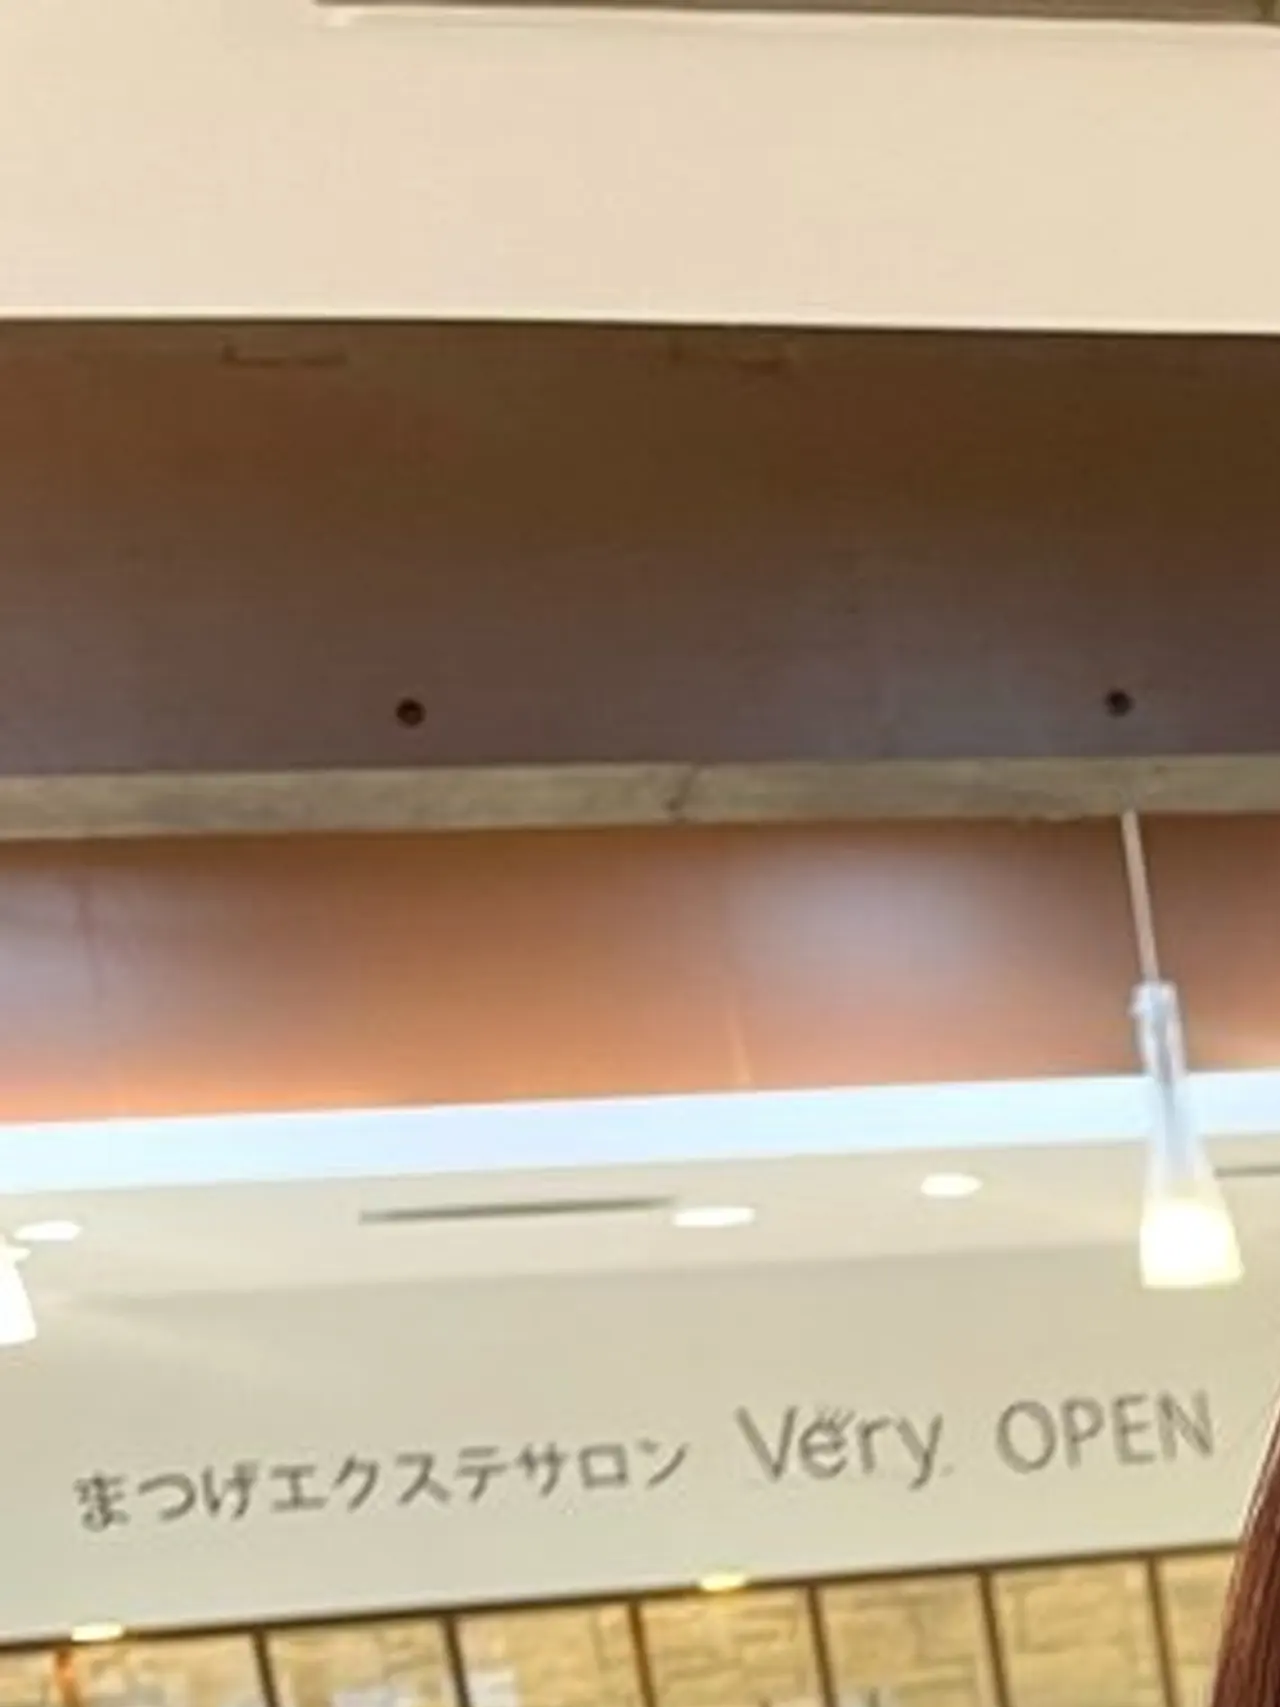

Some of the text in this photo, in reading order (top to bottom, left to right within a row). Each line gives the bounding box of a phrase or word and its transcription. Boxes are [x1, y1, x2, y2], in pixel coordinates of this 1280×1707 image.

[73, 1441, 691, 1532] まつげエクステサロン
[995, 1390, 1215, 1476] OPEN
